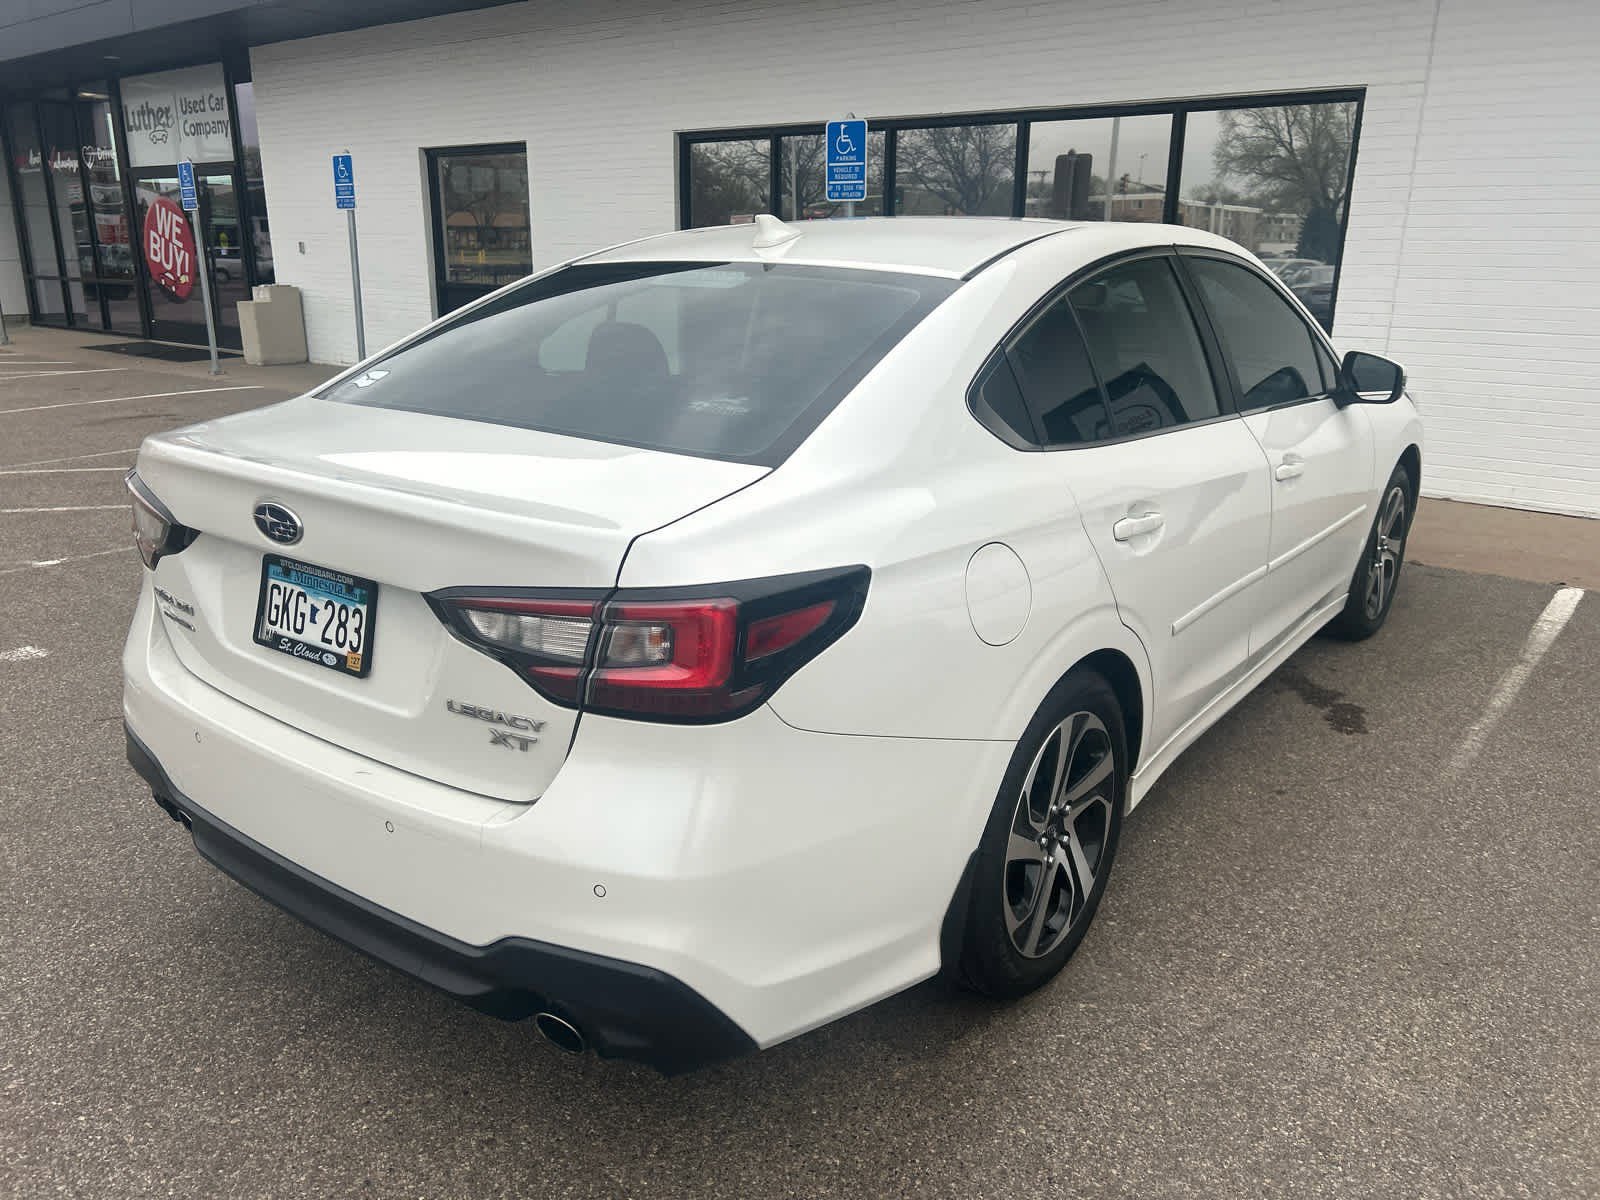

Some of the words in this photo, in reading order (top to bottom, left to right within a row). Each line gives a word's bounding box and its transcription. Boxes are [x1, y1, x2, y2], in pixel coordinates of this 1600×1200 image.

[124, 101, 175, 132] Luther
[180, 96, 206, 115] Used
[208, 93, 225, 112] Car
[183, 119, 230, 139] Company
[155, 203, 183, 248] WE
[150, 229, 189, 277] BUY!
[293, 572, 344, 595] Minnesota
[267, 583, 308, 635] GKG
[320, 599, 363, 653] 283
[293, 642, 321, 662] Cloud
[446, 699, 547, 732] LEGACY
[488, 727, 538, 752] XT
